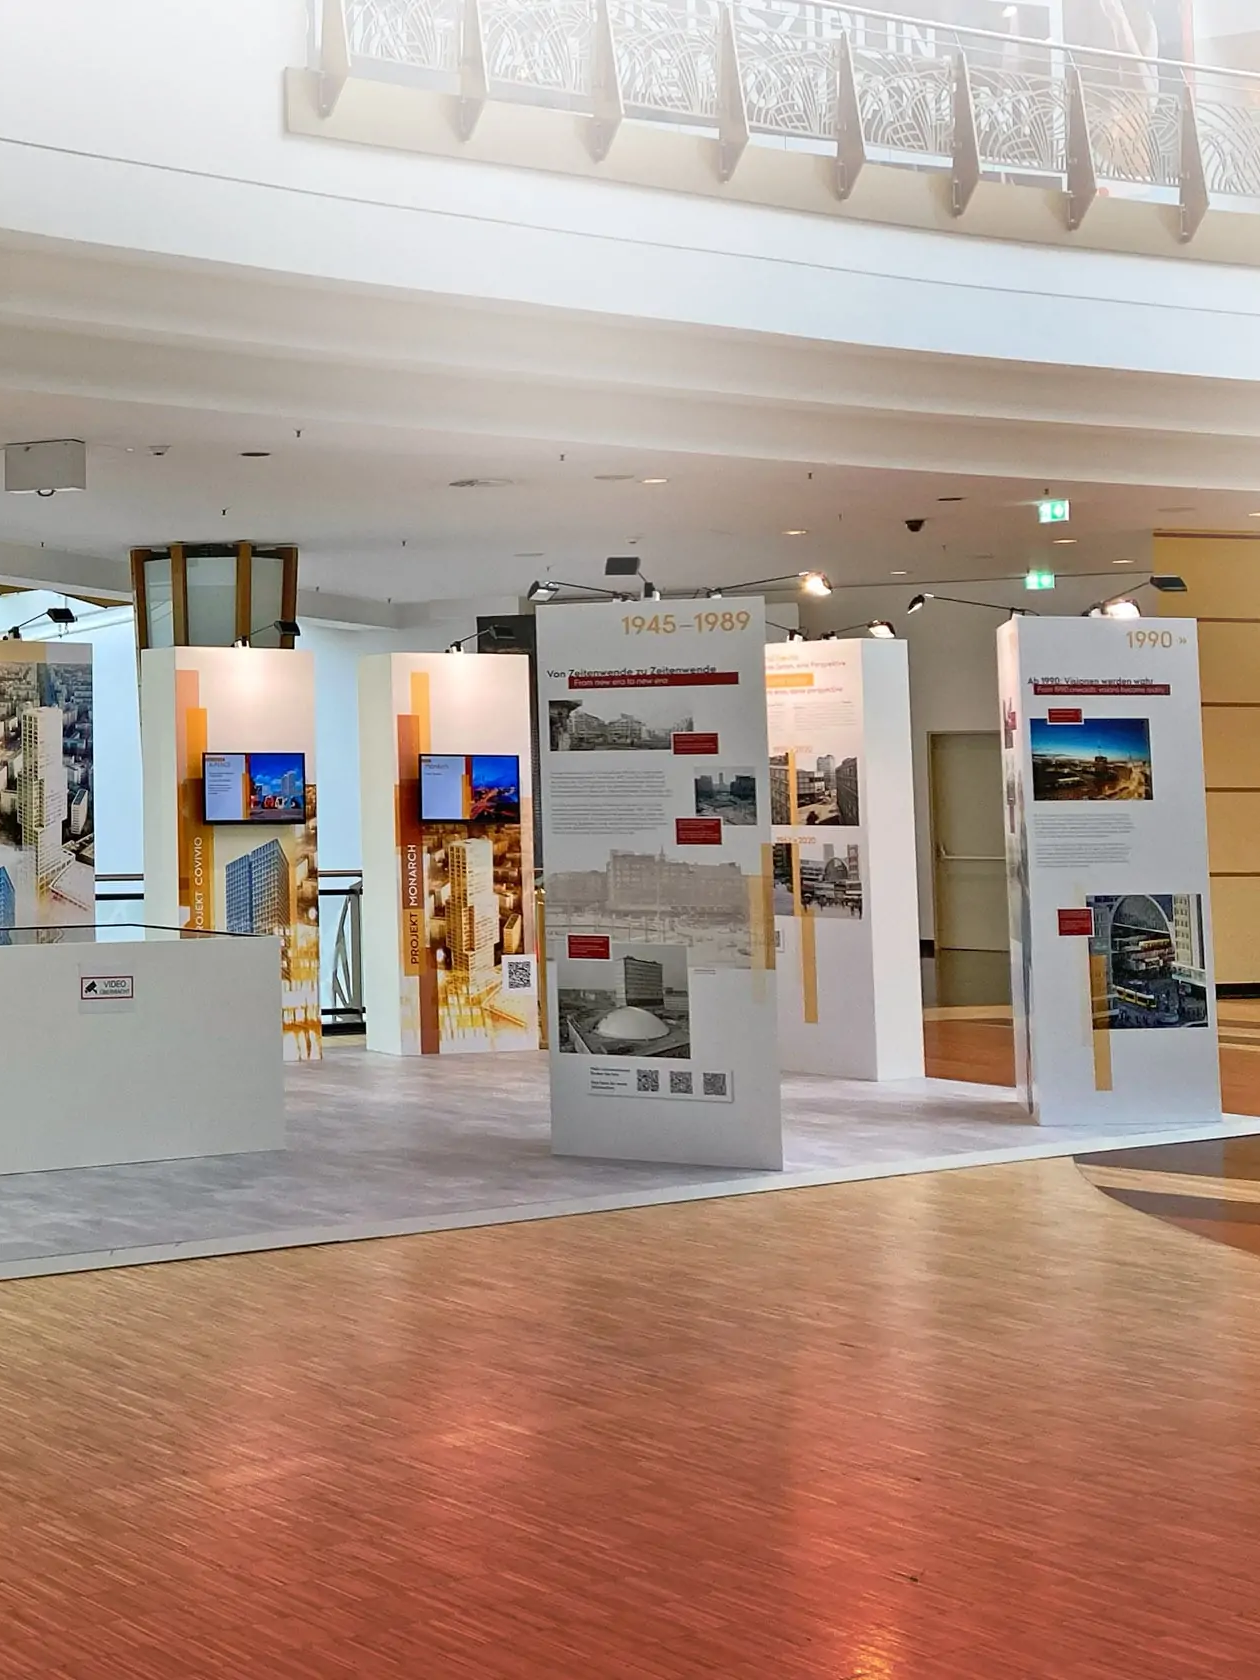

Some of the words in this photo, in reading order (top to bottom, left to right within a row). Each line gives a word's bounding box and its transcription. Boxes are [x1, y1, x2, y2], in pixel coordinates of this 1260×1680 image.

[621, 610, 751, 635] 1945–1989
[1126, 630, 1173, 649] 1990
[547, 669, 566, 678] Von
[650, 664, 717, 675] Zeitenwende
[573, 679, 593, 687] From
[194, 836, 203, 886] COVIVIO
[407, 844, 418, 906] MONARCH
[410, 911, 420, 965] PROJEKT
[103, 979, 127, 988] VIDEO
